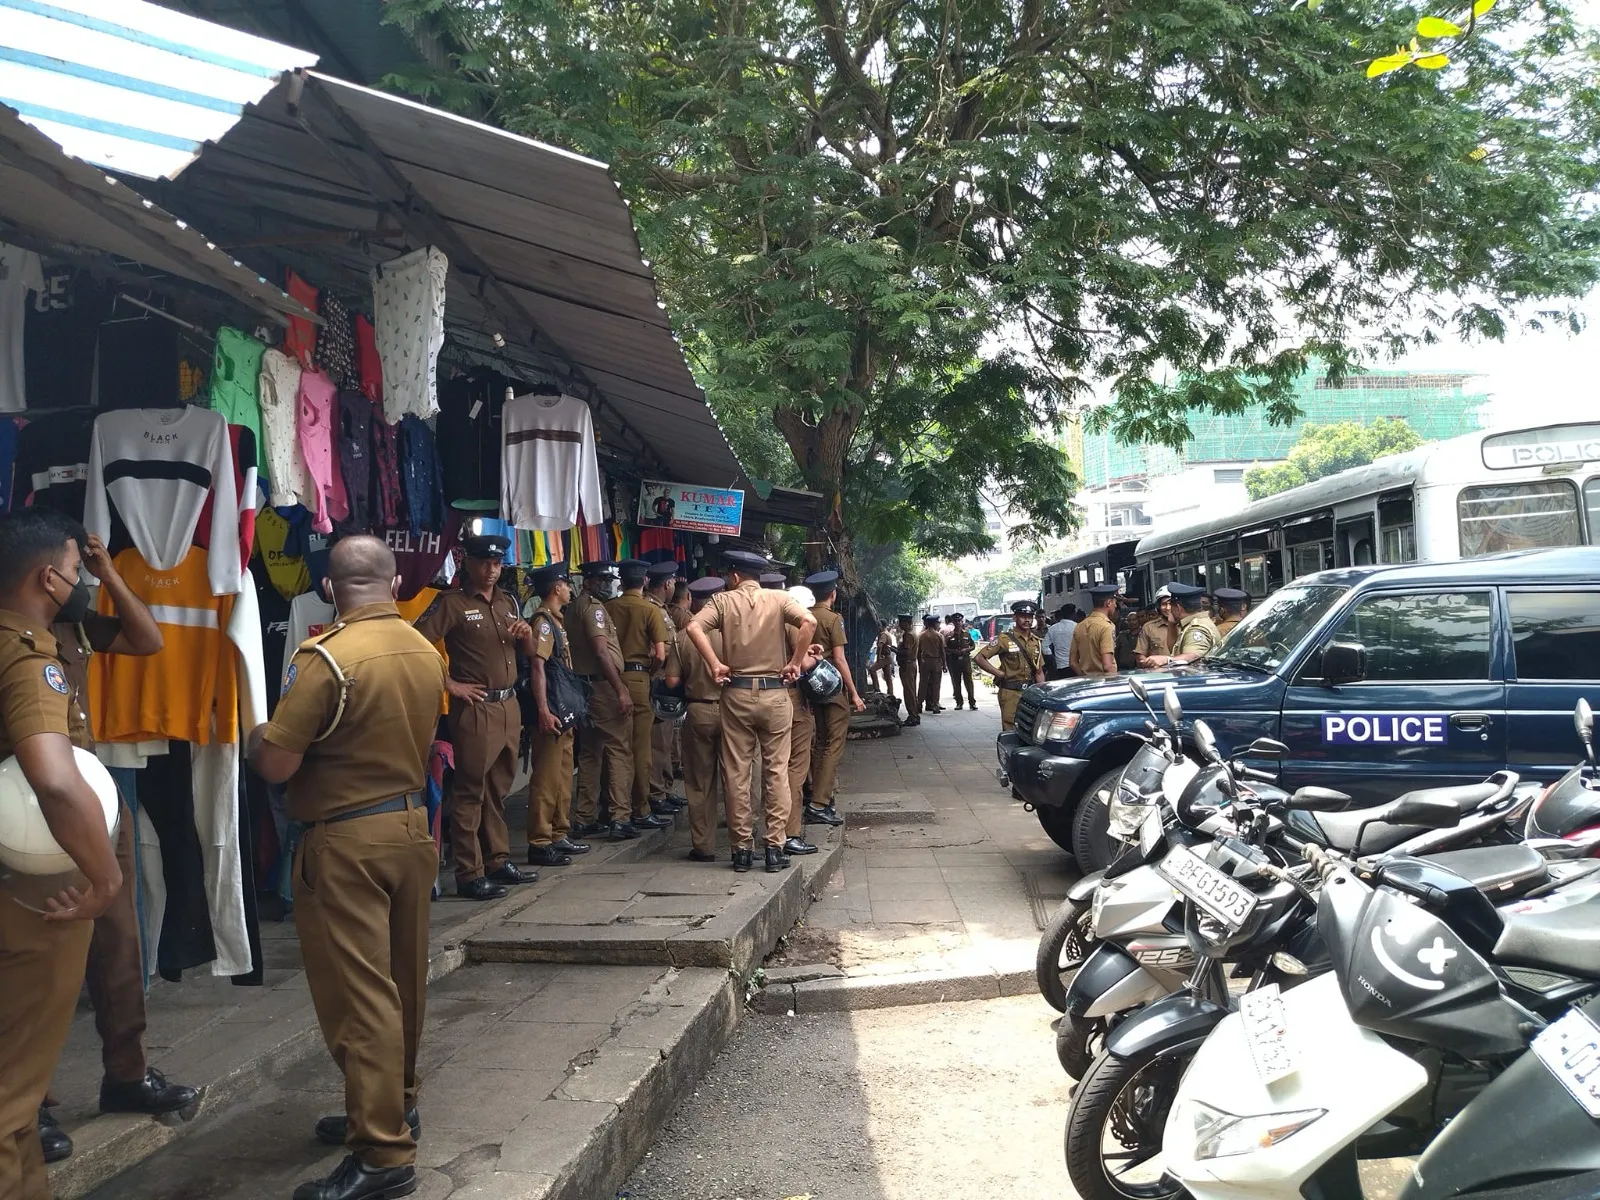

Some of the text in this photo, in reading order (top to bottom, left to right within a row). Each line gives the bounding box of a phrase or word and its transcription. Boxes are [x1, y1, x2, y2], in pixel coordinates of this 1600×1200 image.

[143, 431, 179, 441] BLACK
[681, 491, 736, 507] KUMAR
[692, 503, 726, 514] TEX
[144, 574, 180, 585] BLACK
[1326, 717, 1444, 742] POLICE
[1357, 974, 1392, 1008] HONDA
